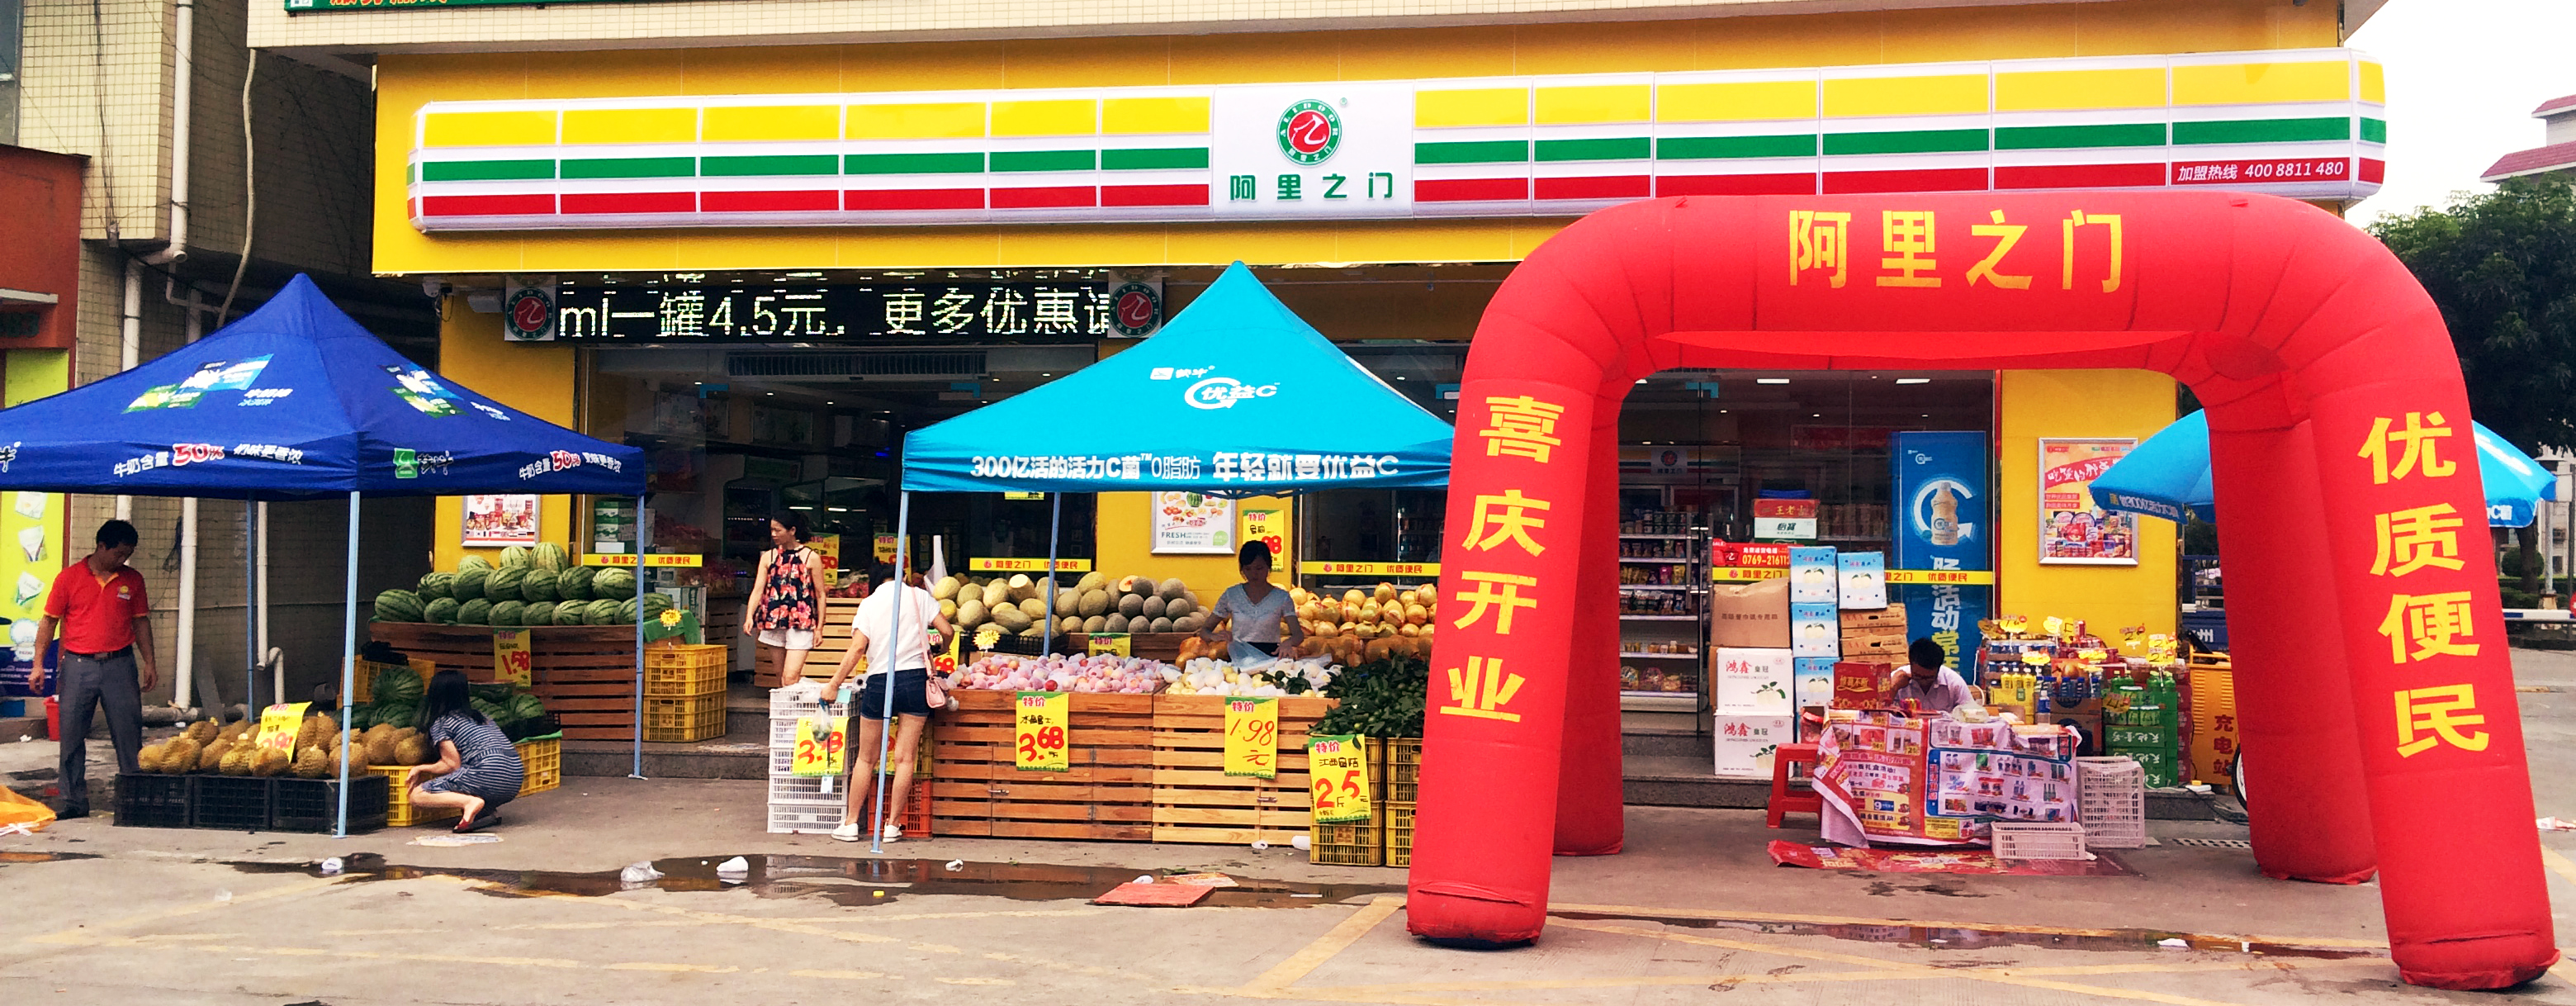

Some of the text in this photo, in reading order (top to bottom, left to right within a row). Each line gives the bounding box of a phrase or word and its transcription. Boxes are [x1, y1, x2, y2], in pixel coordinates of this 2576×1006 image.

[2176, 160, 2344, 183] 加盟热线 400 8811 480
[1229, 171, 1394, 202] 阿里之门
[1788, 208, 2123, 294] 阿里之门
[113, 443, 304, 478] 牛奶含量 50% 奶味更香浓
[1212, 451, 1399, 482] 年轻就要优益C
[1248, 512, 1266, 522] 特价
[657, 556, 690, 565] 优质便民
[996, 560, 1031, 570] 阿里之门
[1336, 564, 1423, 574] 阿里之门 优质便民
[1439, 394, 1565, 723] 喜庆开业
[1742, 569, 1783, 579] 阿里之门
[1928, 572, 1968, 582] 优质便民
[2357, 410, 2490, 759] 优质便民
[1022, 695, 1046, 707] 特价
[1232, 700, 1255, 713] 特价
[1018, 726, 1065, 762] 3.68
[1229, 718, 1275, 747] 1.98
[1315, 740, 1340, 753] 特价
[2213, 714, 2235, 776] 充电站
[1243, 749, 1271, 766] 元
